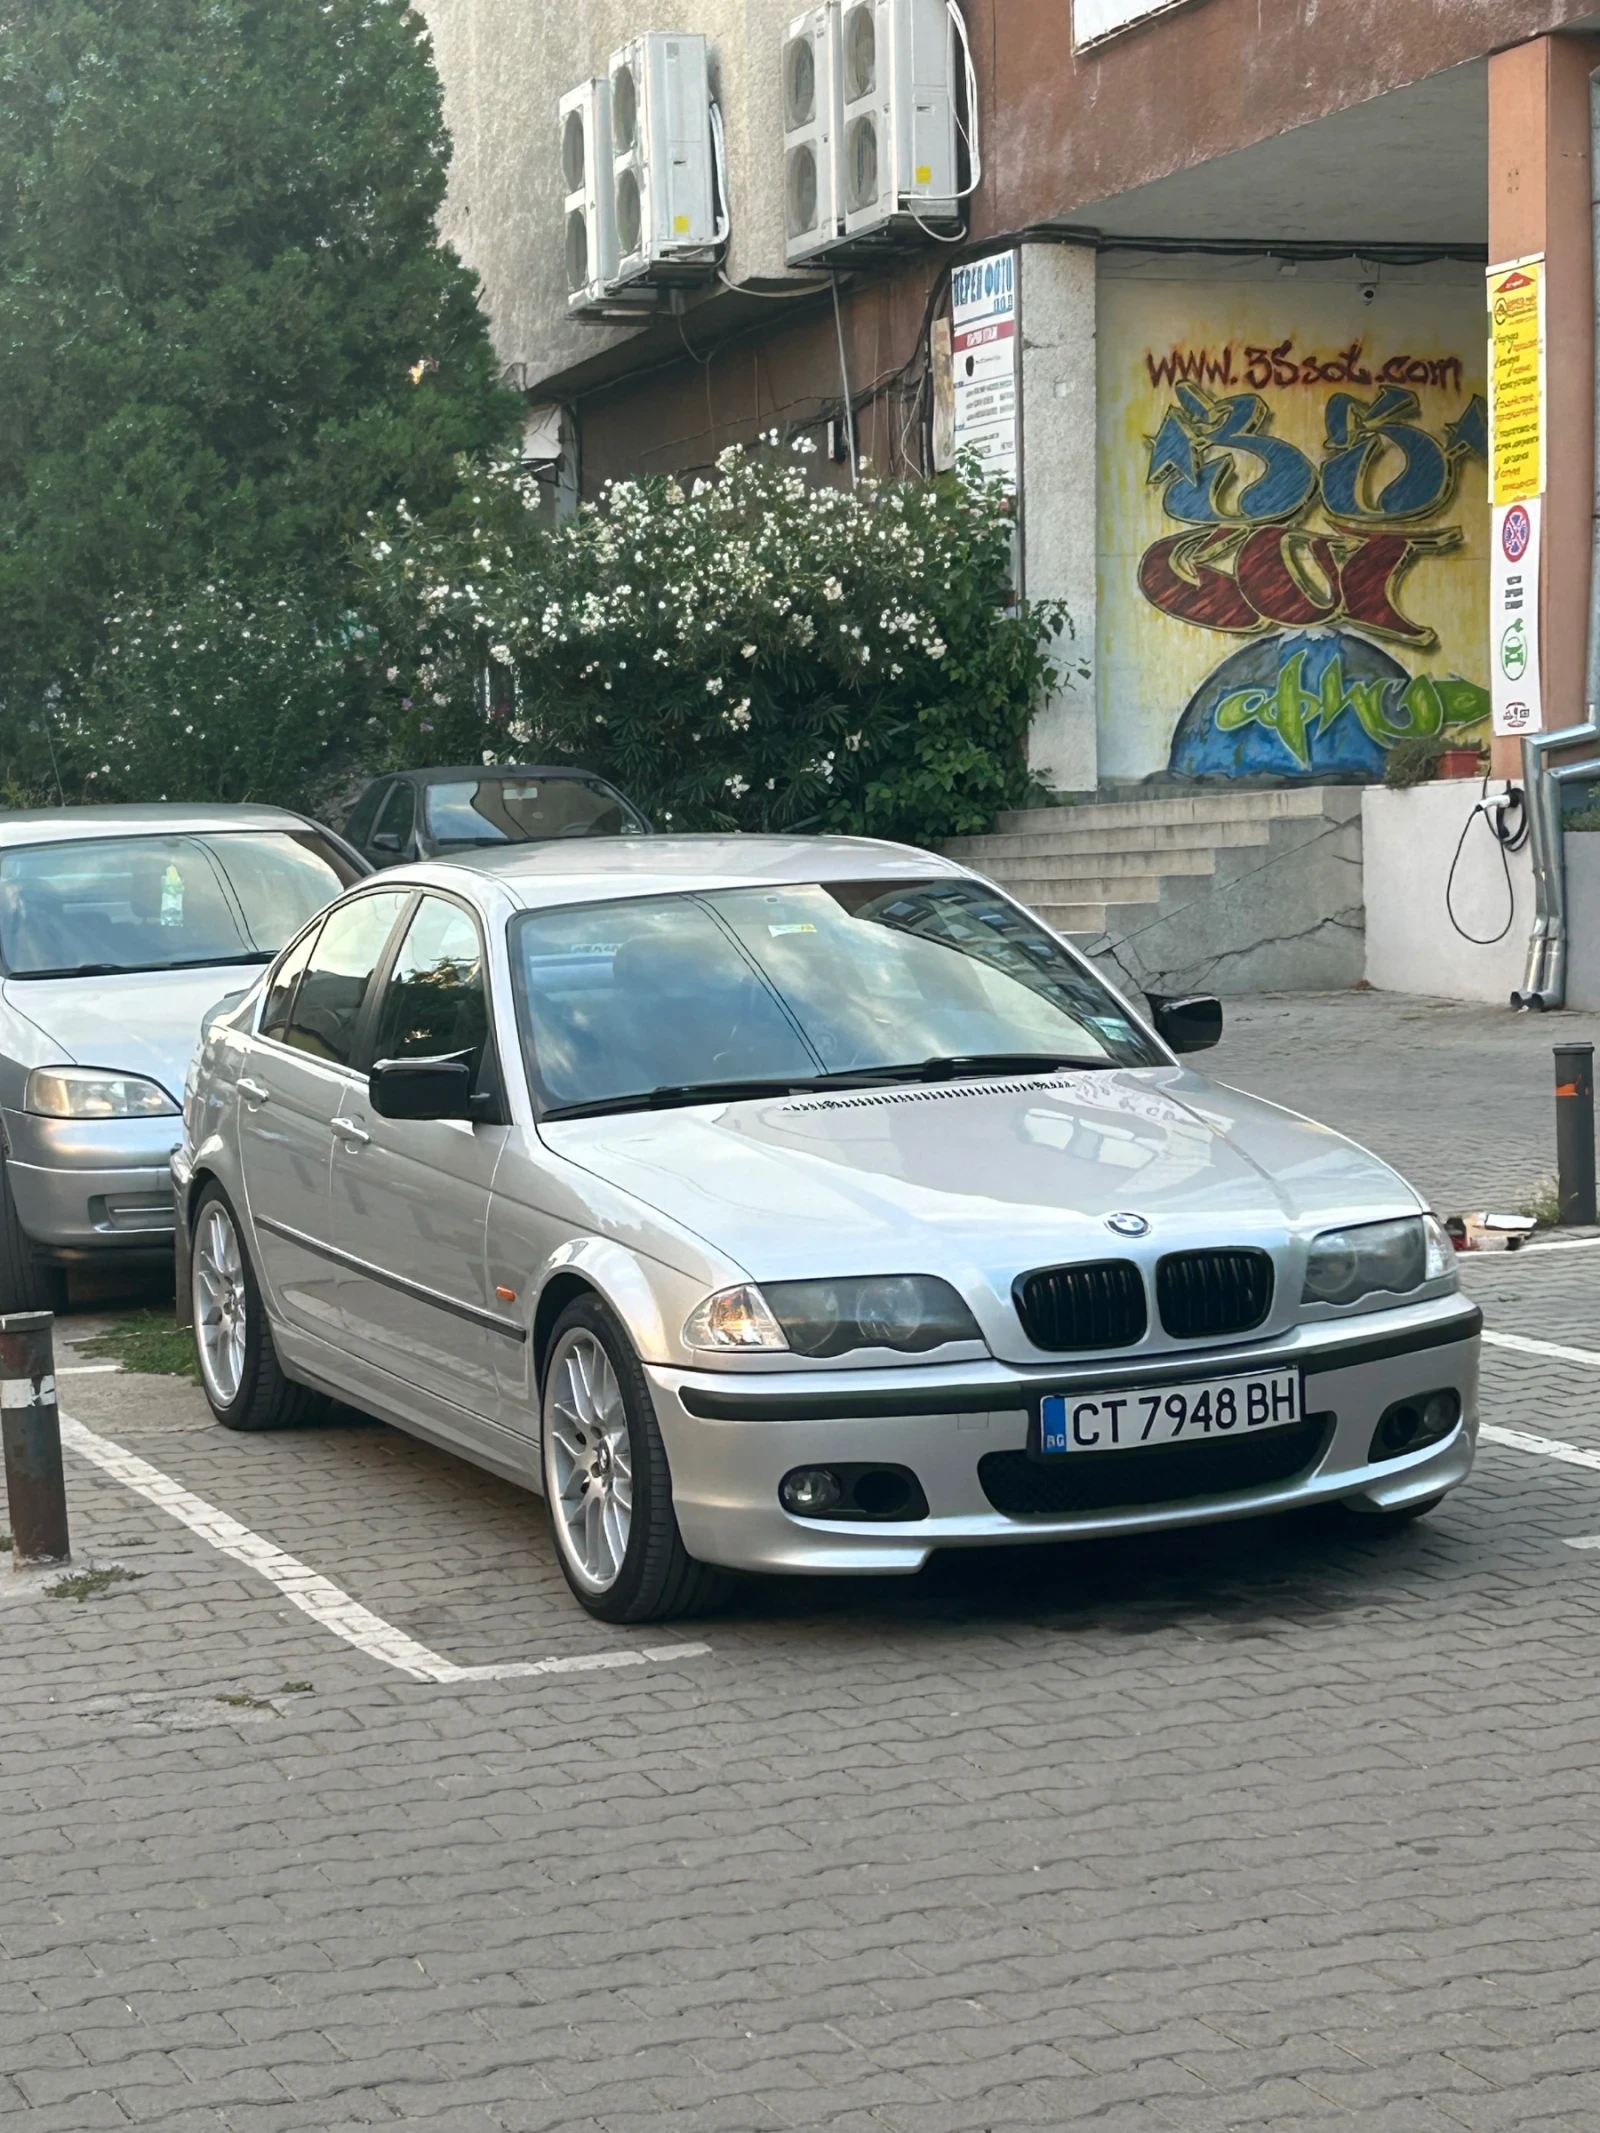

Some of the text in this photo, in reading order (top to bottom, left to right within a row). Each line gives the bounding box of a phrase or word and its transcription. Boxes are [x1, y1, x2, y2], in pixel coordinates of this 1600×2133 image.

[1072, 1376, 1296, 1446] CT 7948 BH
[1046, 1433, 1066, 1449] BG
